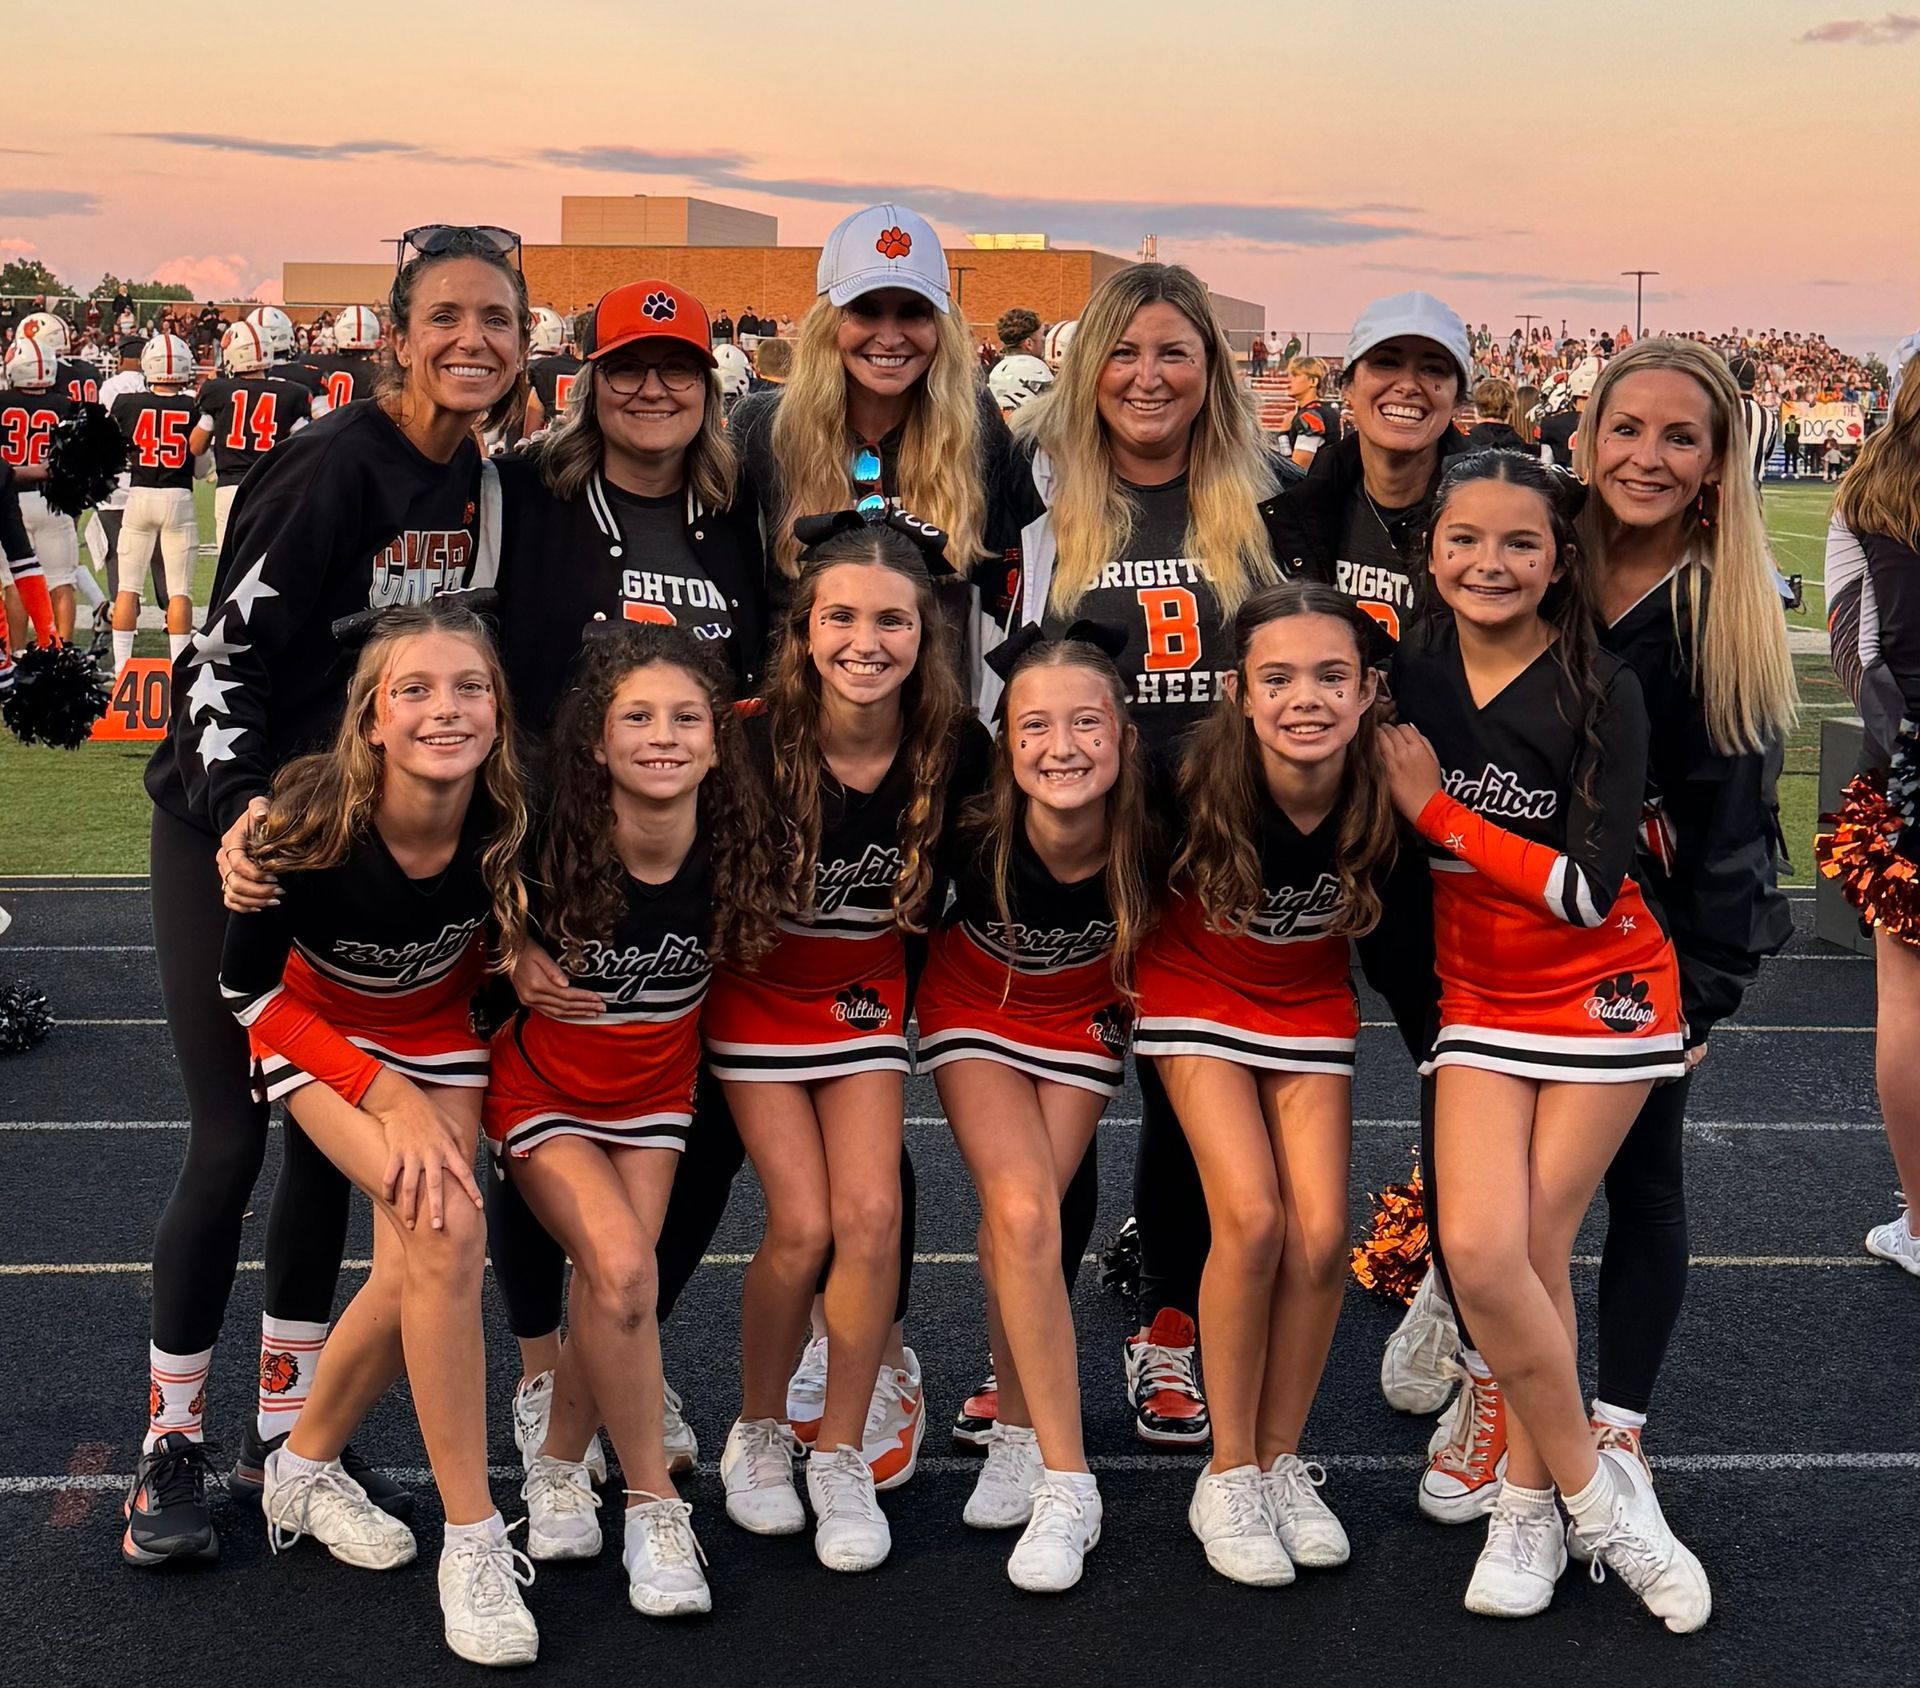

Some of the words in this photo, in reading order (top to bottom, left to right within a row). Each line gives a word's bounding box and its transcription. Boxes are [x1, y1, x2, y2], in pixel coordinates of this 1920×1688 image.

[1, 407, 60, 466] 32
[132, 408, 191, 469] 45
[226, 389, 277, 451] 14
[618, 569, 728, 612] GHTON
[1083, 558, 1214, 592] RIGHT
[1136, 585, 1203, 673] B
[113, 670, 171, 730] 40
[1124, 670, 1226, 704] HEE
[1583, 996, 1658, 1031] Bulldogs
